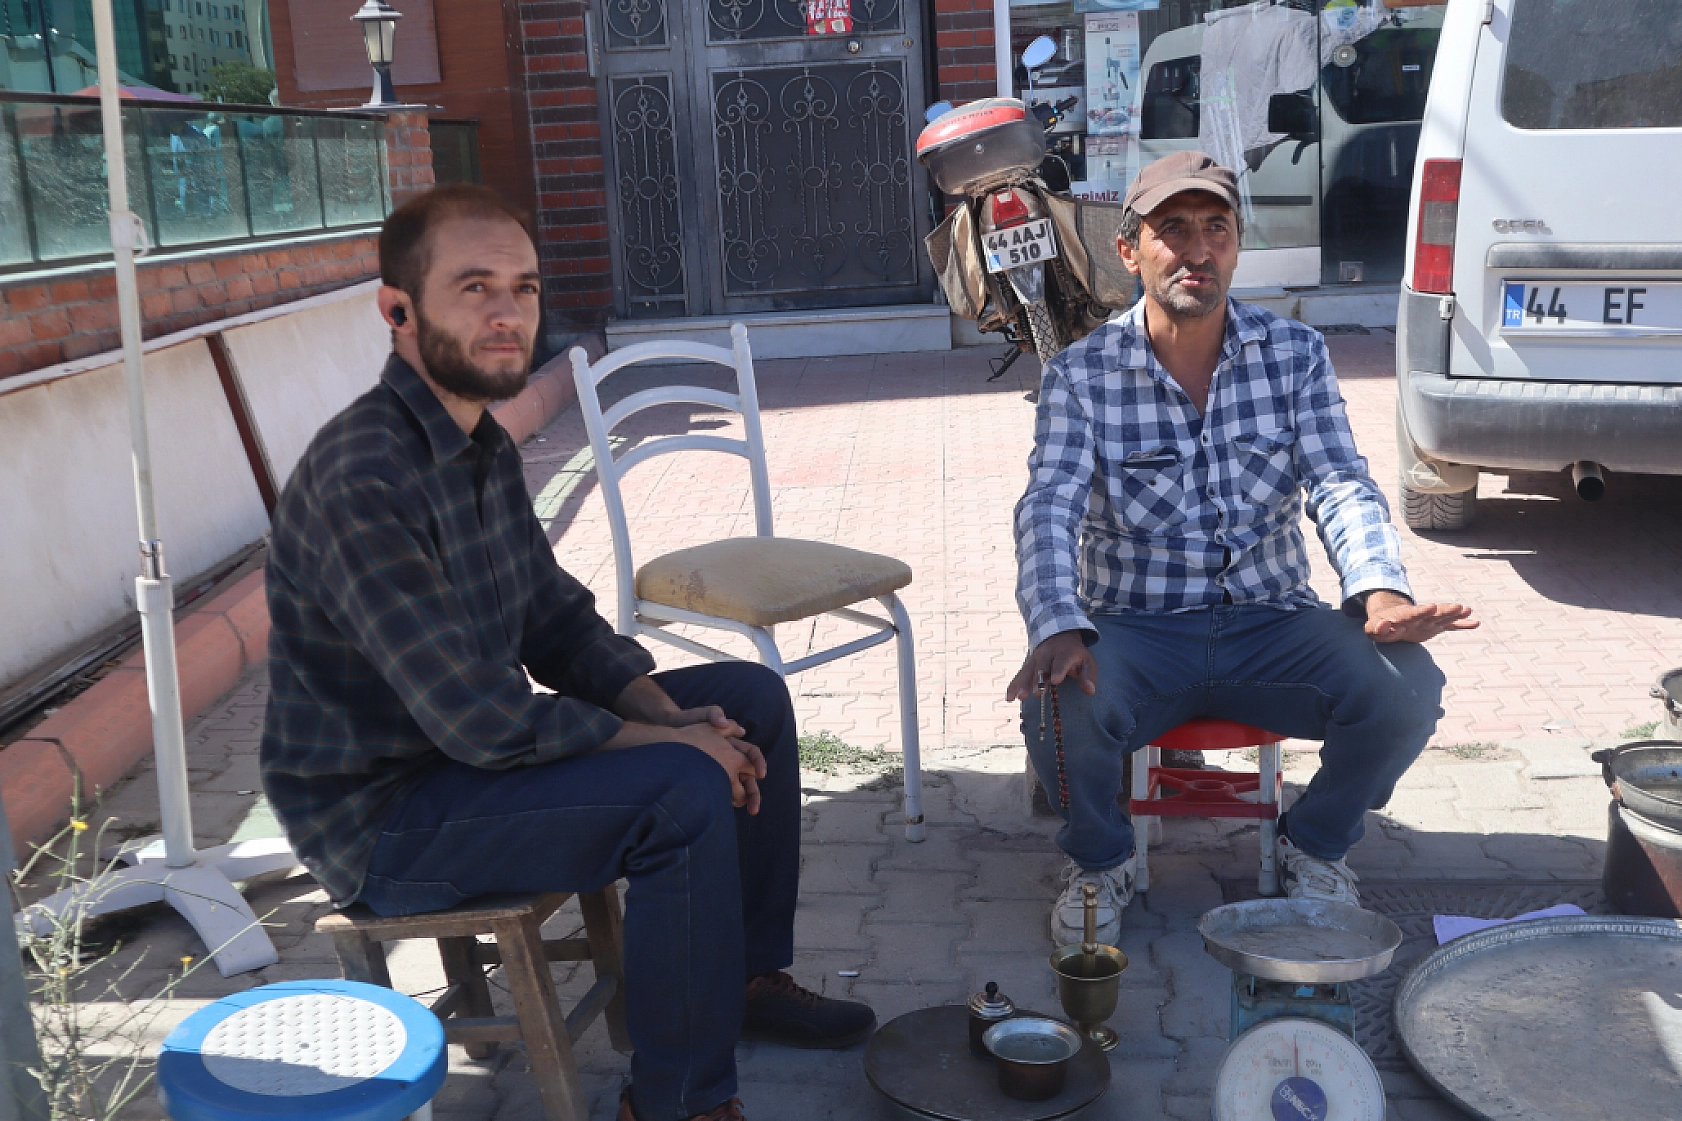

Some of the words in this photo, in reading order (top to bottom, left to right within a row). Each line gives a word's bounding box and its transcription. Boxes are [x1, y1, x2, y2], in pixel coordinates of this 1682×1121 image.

[988, 233, 1008, 251] 44
[1013, 223, 1046, 245] AAJ
[1009, 243, 1041, 264] 510
[1505, 309, 1521, 320] TR
[1526, 287, 1567, 325] 44
[1603, 287, 1648, 325] EF
